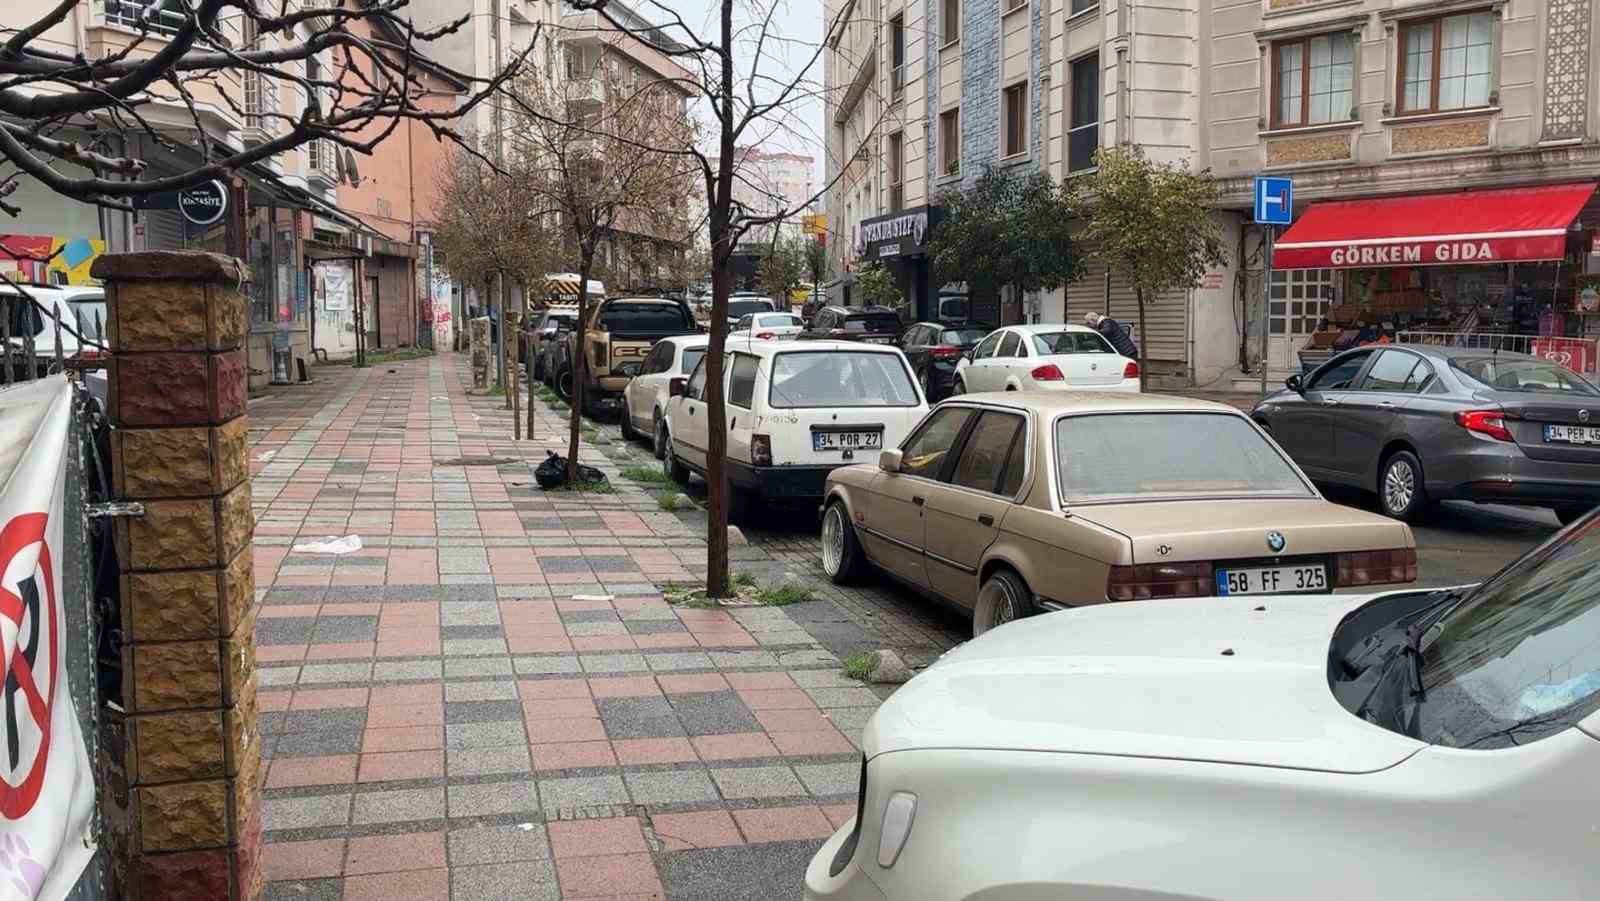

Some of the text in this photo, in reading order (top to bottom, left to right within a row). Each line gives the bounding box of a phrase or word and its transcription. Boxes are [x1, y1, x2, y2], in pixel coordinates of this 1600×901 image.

[1331, 242, 1493, 264] GÖRKEM GIDA
[820, 433, 879, 446] 34 POR 27
[1551, 426, 1562, 438] 34
[1568, 427, 1584, 439] PER
[1228, 568, 1324, 593] 58 FF 325
